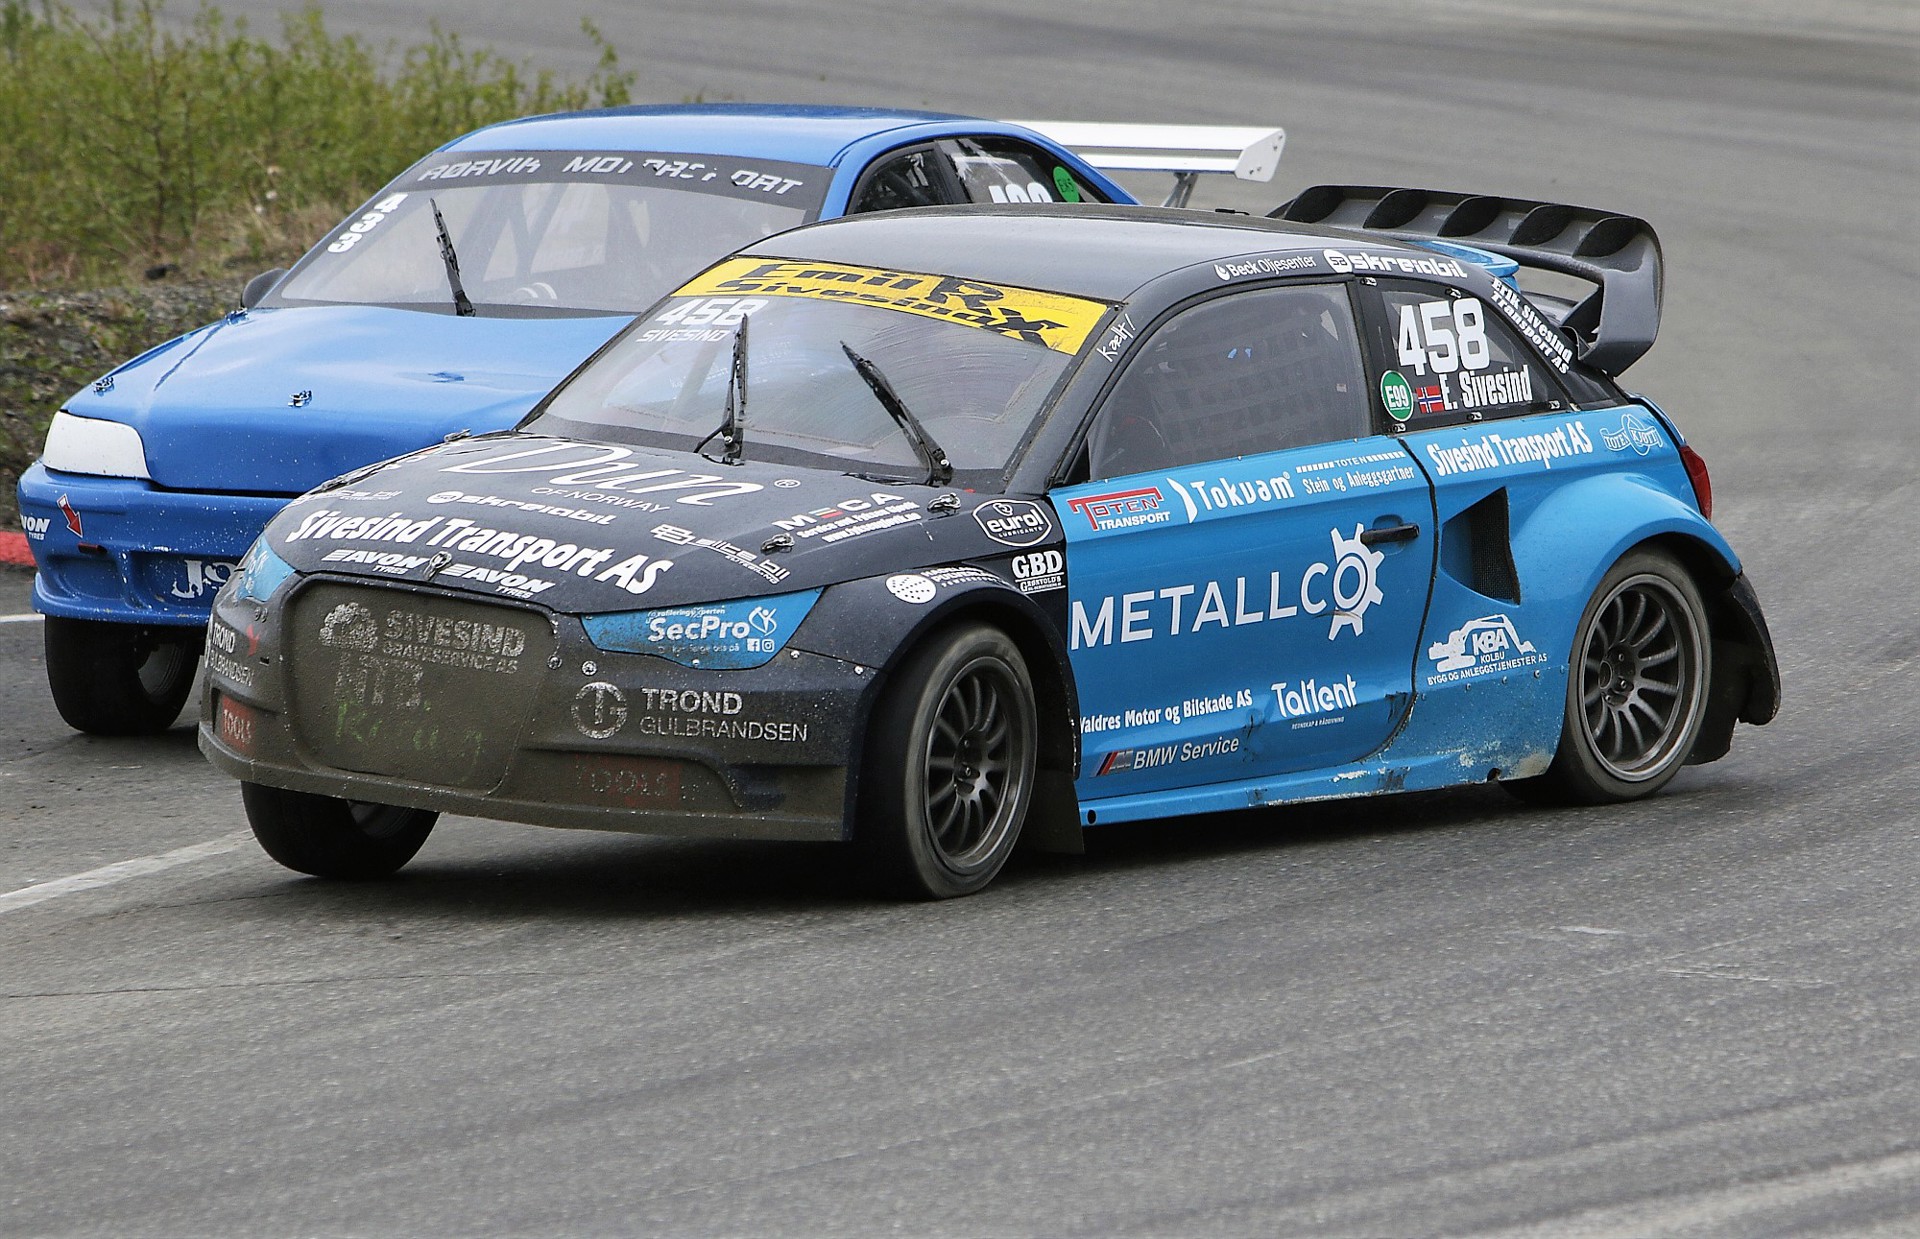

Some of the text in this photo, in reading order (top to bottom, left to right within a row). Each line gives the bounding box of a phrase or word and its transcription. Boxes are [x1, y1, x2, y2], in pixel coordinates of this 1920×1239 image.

[327, 193, 408, 253] 334
[1226, 255, 1317, 277] Beck Oljesenter
[655, 298, 769, 326] 458
[1491, 277, 1573, 364] Erik Sivesind
[641, 329, 731, 342] SIVESIND
[1398, 297, 1490, 376] 458
[1491, 290, 1570, 375] Transport AS
[1384, 384, 1410, 408] E99
[1438, 364, 1533, 411] E. Sivesind
[1335, 457, 1368, 468] TOTEN
[1426, 421, 1593, 477] Sivesind Transport AS
[1302, 465, 1415, 495] Stein og Anleggsgartner
[530, 487, 671, 514] OF NORWAY
[1066, 486, 1164, 531] TOTEN
[28, 532, 45, 540] TYRES
[986, 509, 1045, 534] eurol
[998, 526, 1043, 538] LUBRICANTS
[1099, 511, 1171, 531] TRANSPORT
[284, 509, 675, 595] Sivesind Transport AS
[1012, 550, 1063, 579] GBD
[340, 550, 556, 593] AVON AVON
[372, 565, 533, 599] TYRES TYRES
[1071, 551, 1366, 650] METALLCO
[211, 622, 236, 653] TROND
[384, 609, 526, 657] SIVESIND
[647, 615, 750, 642] SecPro
[1472, 628, 1510, 655] KBA
[1427, 653, 1548, 686] BYGG OG ANLEGGSTJENESTER AS
[1480, 652, 1505, 664] KOLBU
[641, 687, 743, 715] TROND
[1271, 674, 1357, 717] Tallent
[1080, 688, 1253, 734] Valdres Motor og Bilskade AS
[639, 716, 809, 742] GULBRANDSEN
[1133, 744, 1178, 770] BMW
[1180, 736, 1239, 761] Service
